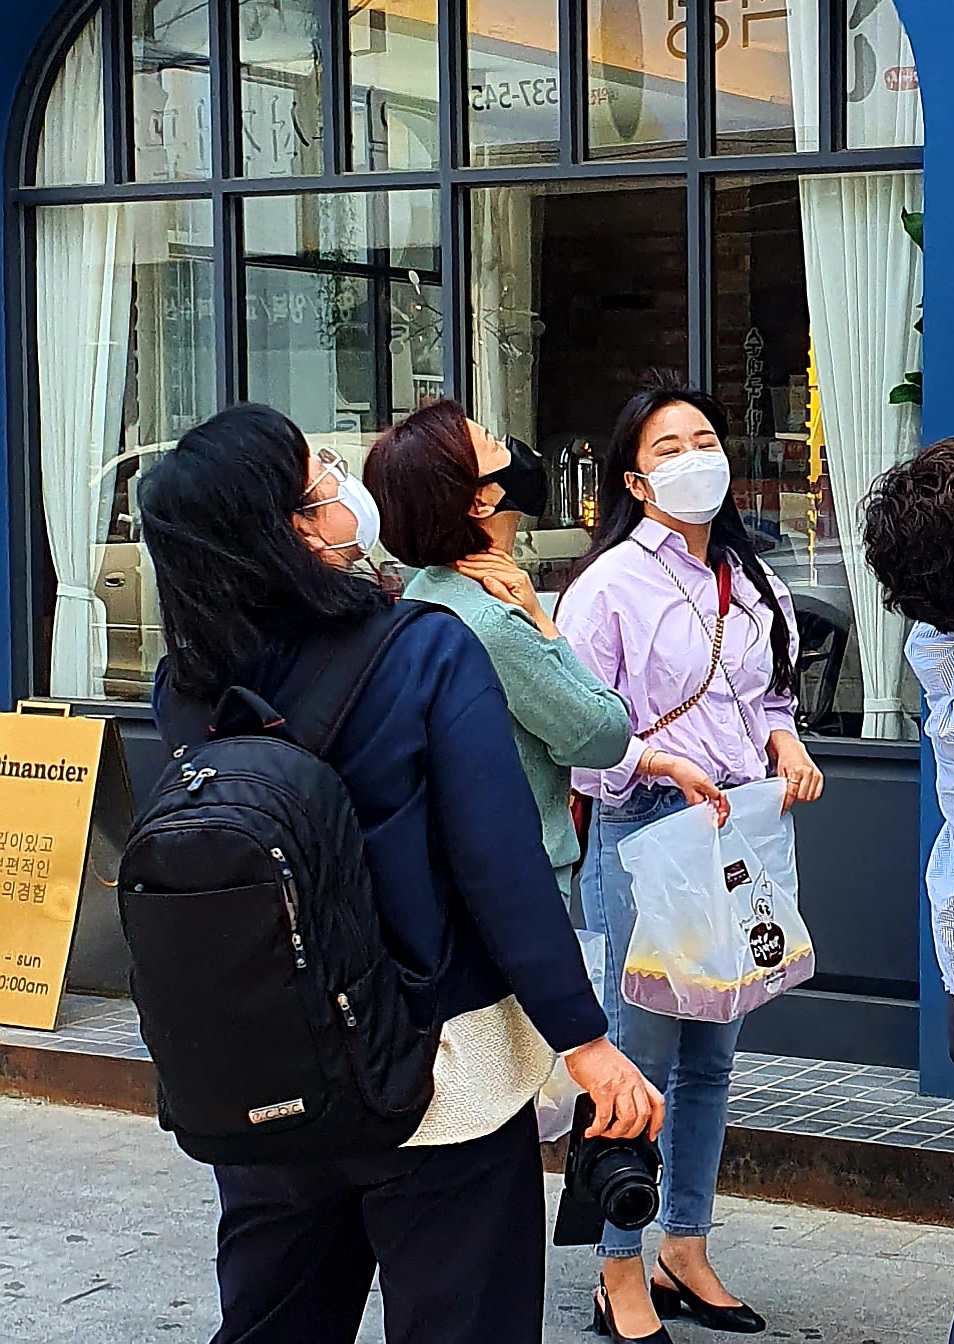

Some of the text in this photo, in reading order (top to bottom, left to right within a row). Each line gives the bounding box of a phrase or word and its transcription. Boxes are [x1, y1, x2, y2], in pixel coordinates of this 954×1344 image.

[0, 754, 88, 783] inancier
[0, 856, 50, 879] 편적인
[0, 881, 46, 904] 의경험
[16, 954, 41, 969] sun
